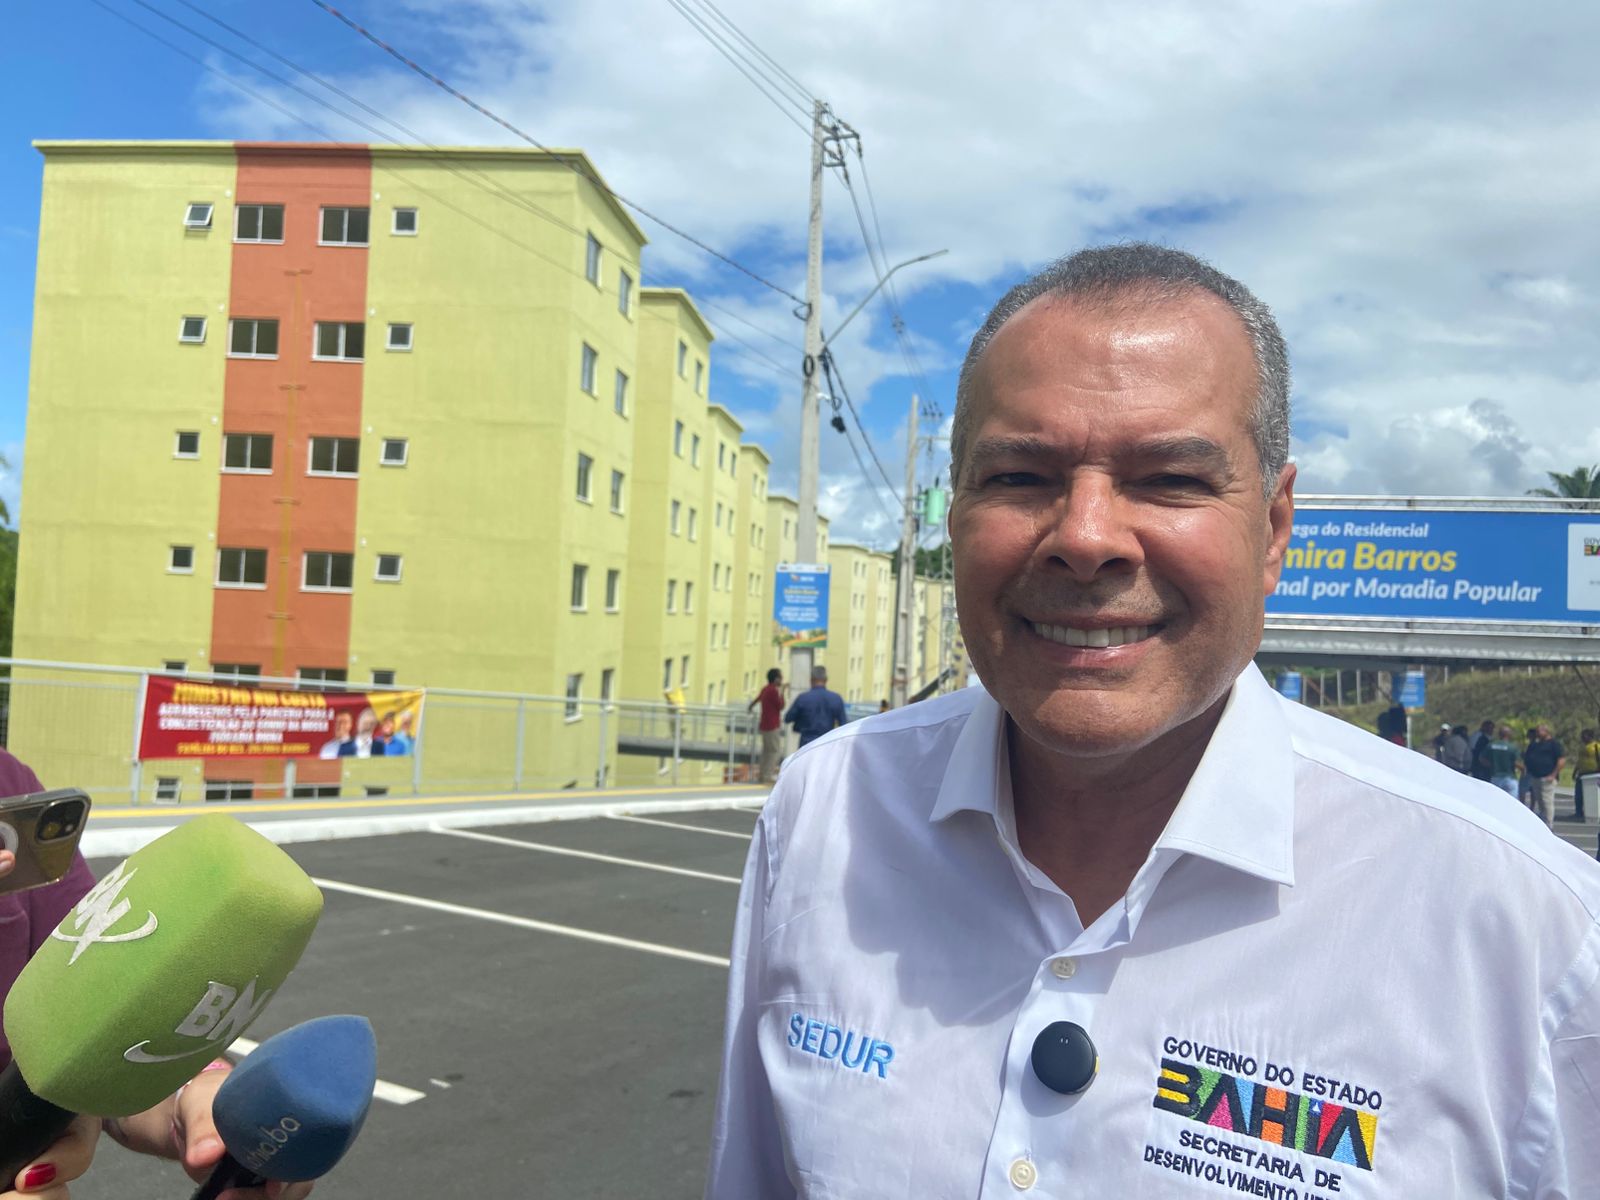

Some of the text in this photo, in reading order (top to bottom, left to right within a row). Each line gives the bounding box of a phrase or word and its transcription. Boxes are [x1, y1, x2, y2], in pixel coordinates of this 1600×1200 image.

[1321, 522, 1340, 536] do
[1344, 522, 1429, 538] Residencial
[1353, 542, 1456, 572] Barros
[1312, 580, 1350, 600] por
[1354, 577, 1448, 600] Moradia
[1453, 579, 1542, 605] Popular
[787, 1012, 895, 1079] SEDUR
[1163, 1036, 1383, 1110] GOVERNO DO ESTADO
[1153, 1057, 1378, 1172] BAHIA
[1143, 1144, 1298, 1200] DESENVOLVIMENTO
[1179, 1129, 1342, 1192] SECRETARIA DE
